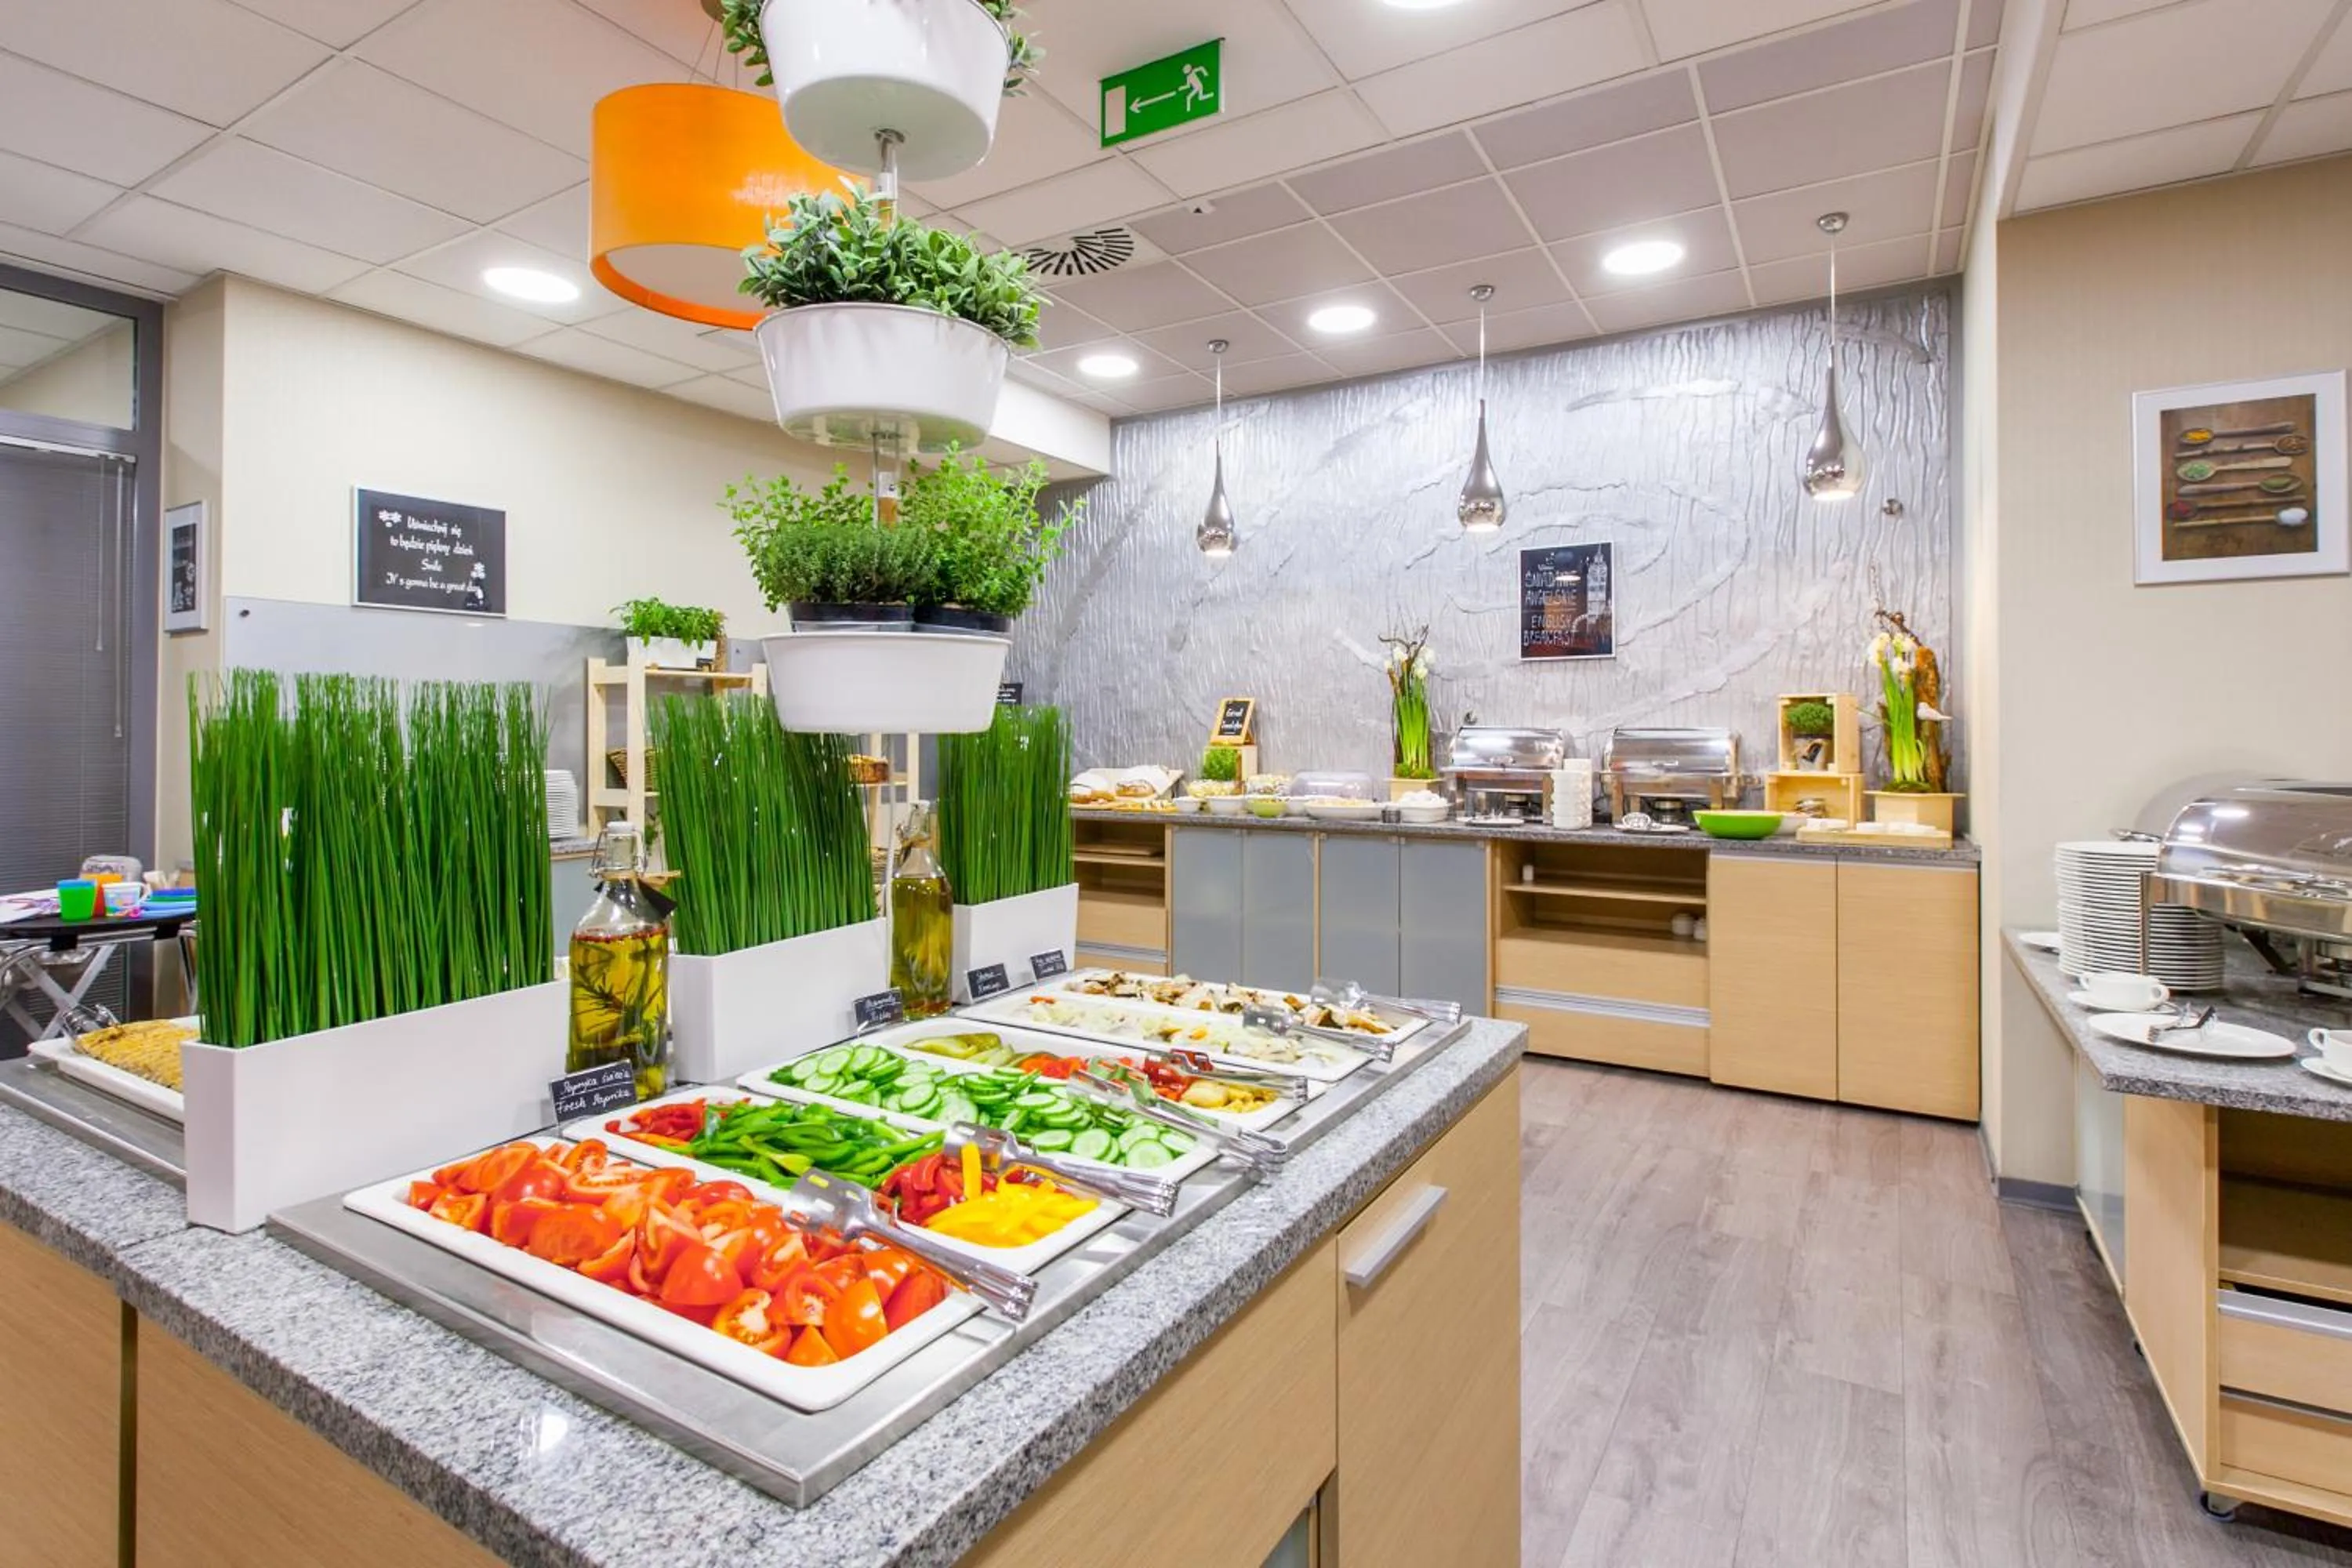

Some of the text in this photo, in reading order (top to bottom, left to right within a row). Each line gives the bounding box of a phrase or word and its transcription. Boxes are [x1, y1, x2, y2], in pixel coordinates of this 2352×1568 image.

[390, 535, 399, 546] to
[421, 558, 443, 572] Smile
[429, 576, 438, 589] be
[446, 582, 466, 594] great
[1531, 614, 1573, 629] ENGLISH
[1523, 630, 1575, 647] BREAKFAST
[556, 1097, 586, 1114] Fresh
